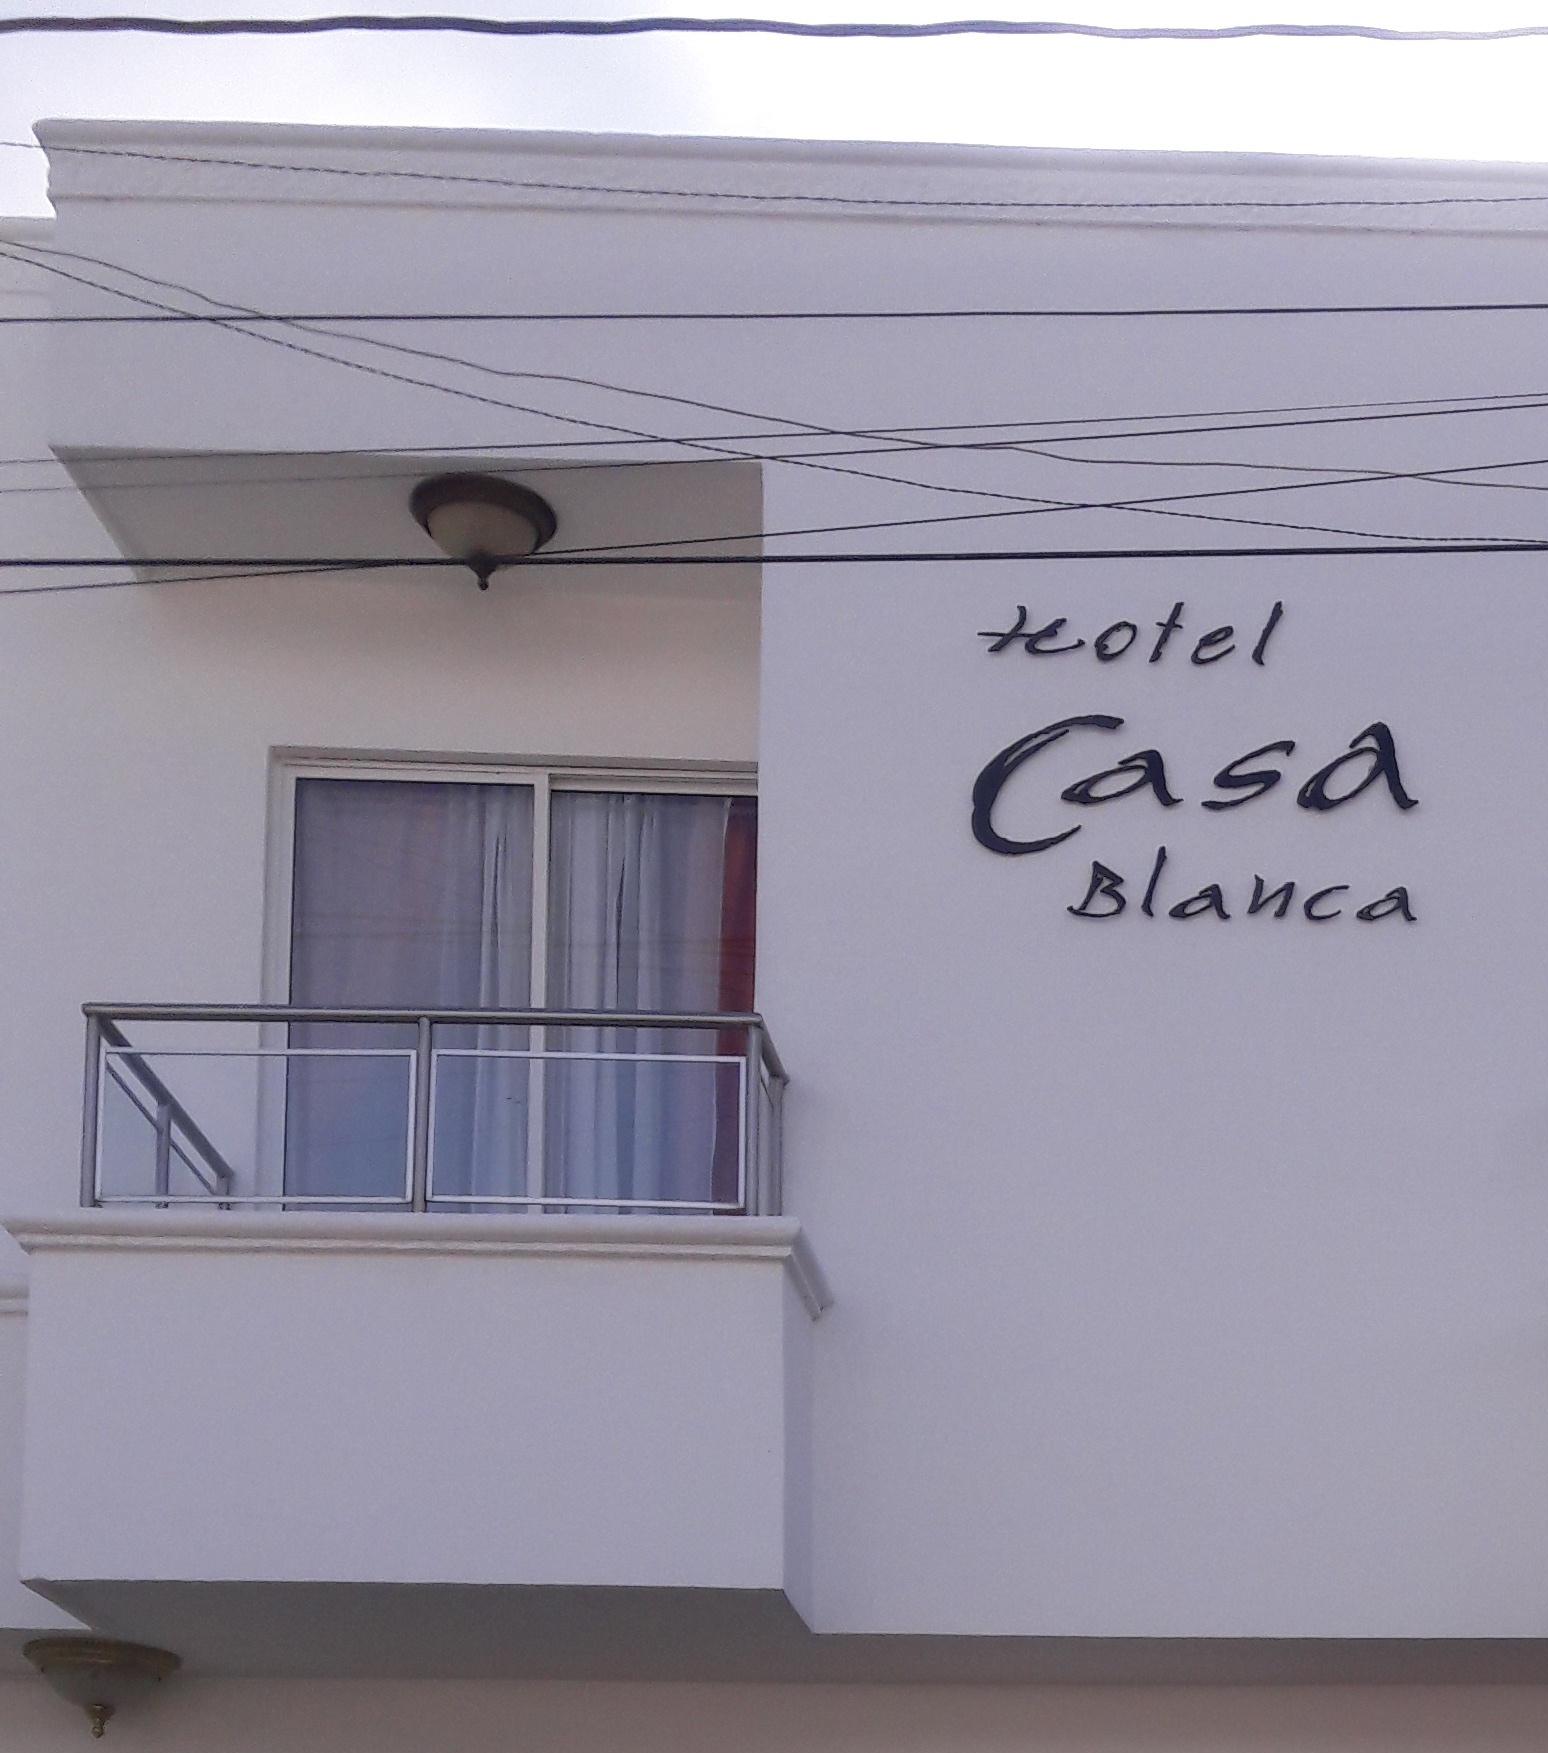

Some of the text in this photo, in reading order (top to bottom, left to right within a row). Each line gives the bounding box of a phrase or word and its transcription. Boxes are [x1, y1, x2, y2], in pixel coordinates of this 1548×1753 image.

[977, 600, 1284, 667] Hotel
[971, 714, 1420, 858] Casa
[1066, 845, 1418, 924] Blanca
